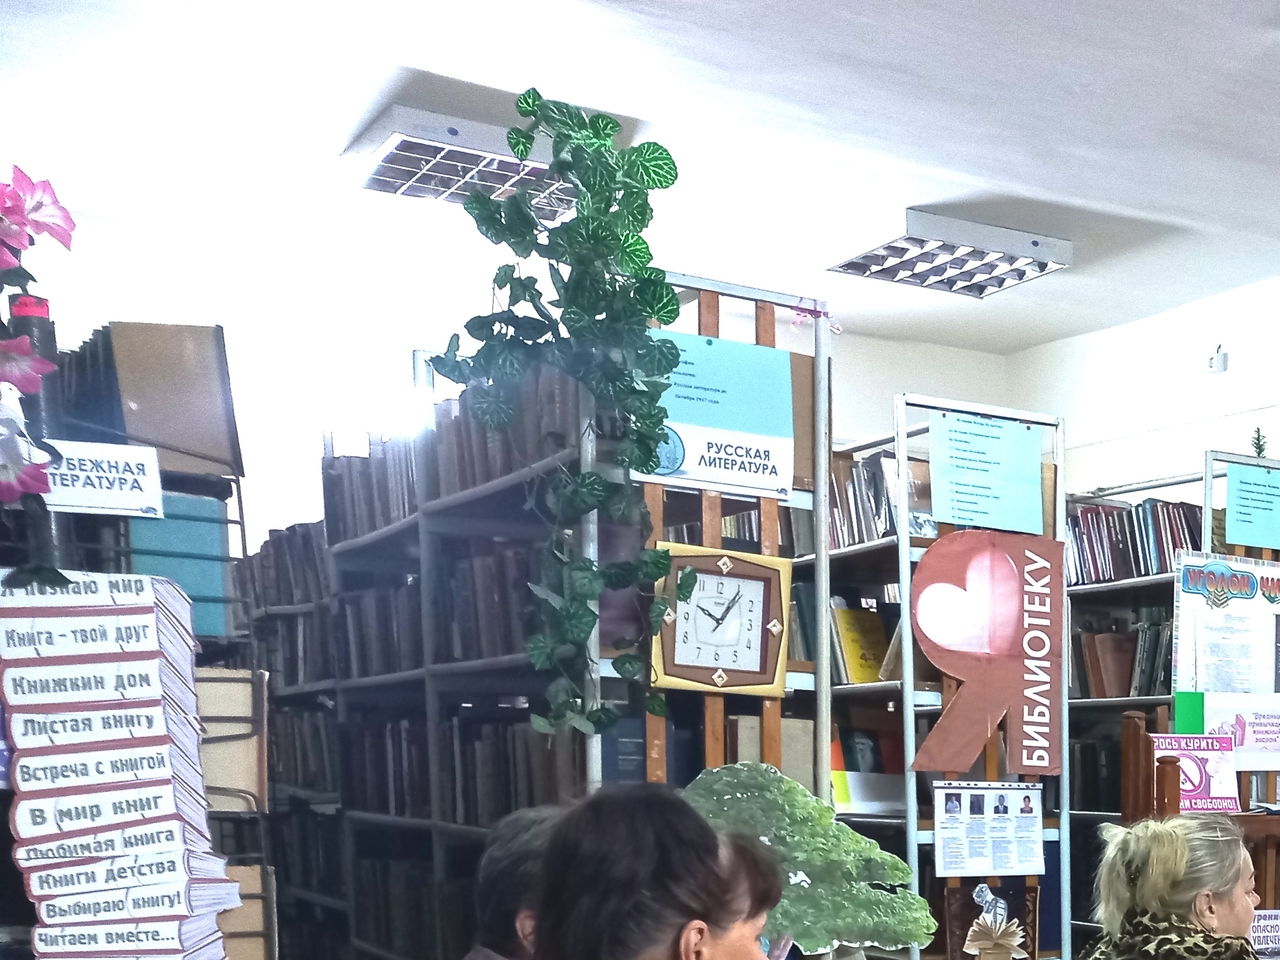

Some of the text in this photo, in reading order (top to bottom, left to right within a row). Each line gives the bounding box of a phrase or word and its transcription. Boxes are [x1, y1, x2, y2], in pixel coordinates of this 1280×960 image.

[707, 441, 770, 462] РУССКАЯ
[698, 454, 779, 477] ЛИТЕРАТУРА
[108, 578, 144, 596] мир
[1187, 569, 1252, 595] УГОЛОК
[5, 628, 54, 648] Книга
[71, 624, 108, 643] твой
[115, 624, 149, 644] друг
[1022, 549, 1051, 767] БИБЛИОТЕКУ
[11, 673, 151, 695] Книжкин дом
[21, 714, 154, 736] Листая книгу
[1181, 738, 1219, 750] КУРИТЬ
[19, 762, 89, 783] Встреча
[110, 753, 165, 773] книгой
[29, 795, 163, 826] В мир книг
[123, 829, 175, 848] книга
[38, 860, 177, 891] Книги детства
[46, 890, 182, 919] Выбираю книгу!
[38, 932, 98, 947] Читаем
